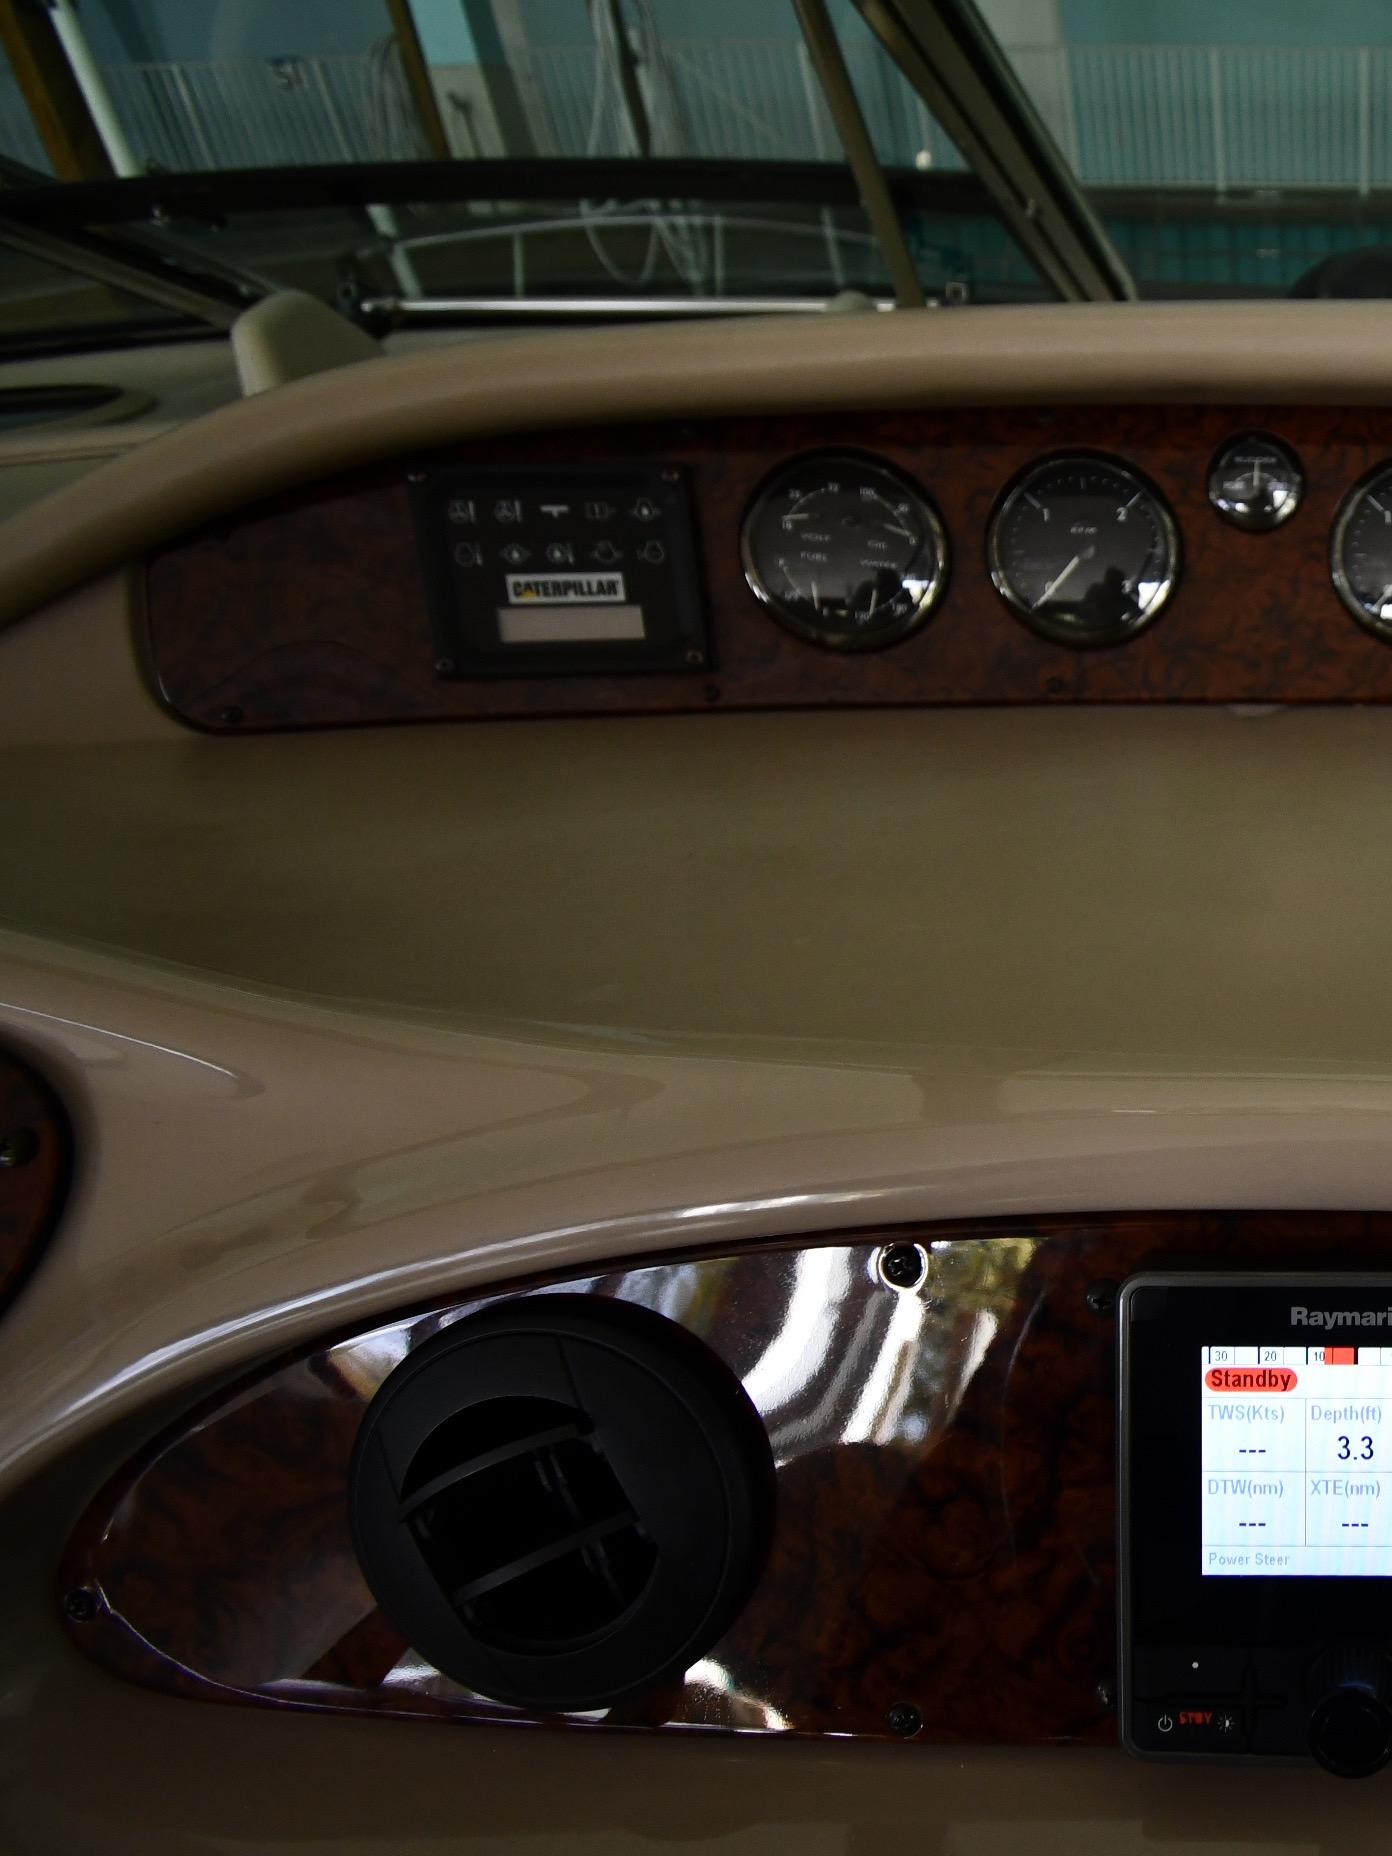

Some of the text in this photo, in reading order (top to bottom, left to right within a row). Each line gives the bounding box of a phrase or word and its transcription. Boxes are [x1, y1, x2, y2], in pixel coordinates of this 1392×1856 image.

[1116, 506, 1129, 523] 2
[512, 580, 619, 598] CATERPILLAR
[1215, 1351, 1228, 1362] 30
[1264, 1351, 1277, 1362] 20
[1314, 1352, 1326, 1362] 10
[1211, 1370, 1291, 1392] Standby
[1208, 1405, 1285, 1424] TWS(Kts)
[1311, 1405, 1382, 1424] Depth(ft)
[1337, 1436, 1374, 1460] 3.3
[1208, 1479, 1284, 1498] DTW(nm)
[1311, 1480, 1381, 1499] XTE(nm)
[1209, 1552, 1290, 1566] Power Steer
